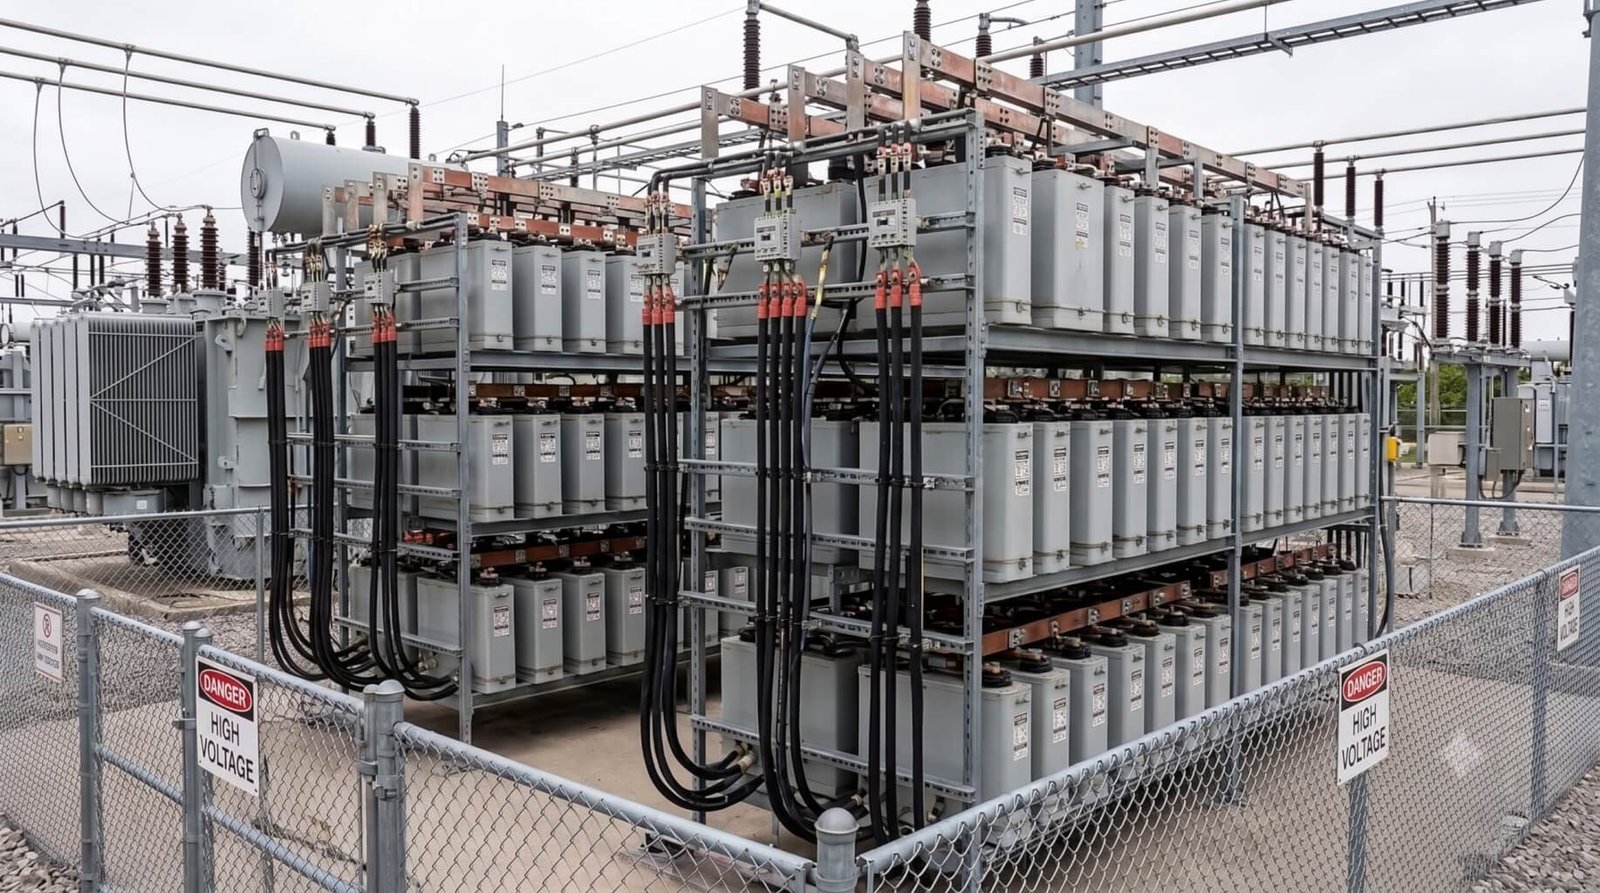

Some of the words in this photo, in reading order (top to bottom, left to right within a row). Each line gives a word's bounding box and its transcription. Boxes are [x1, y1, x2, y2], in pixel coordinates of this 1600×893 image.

[204, 675, 246, 708] DANGER
[1347, 668, 1382, 698] DANGER
[211, 711, 240, 746] HIGH
[1353, 703, 1377, 735] HIGH
[200, 734, 254, 784] VOLTAGE
[1342, 727, 1386, 770] VOLTAGE
